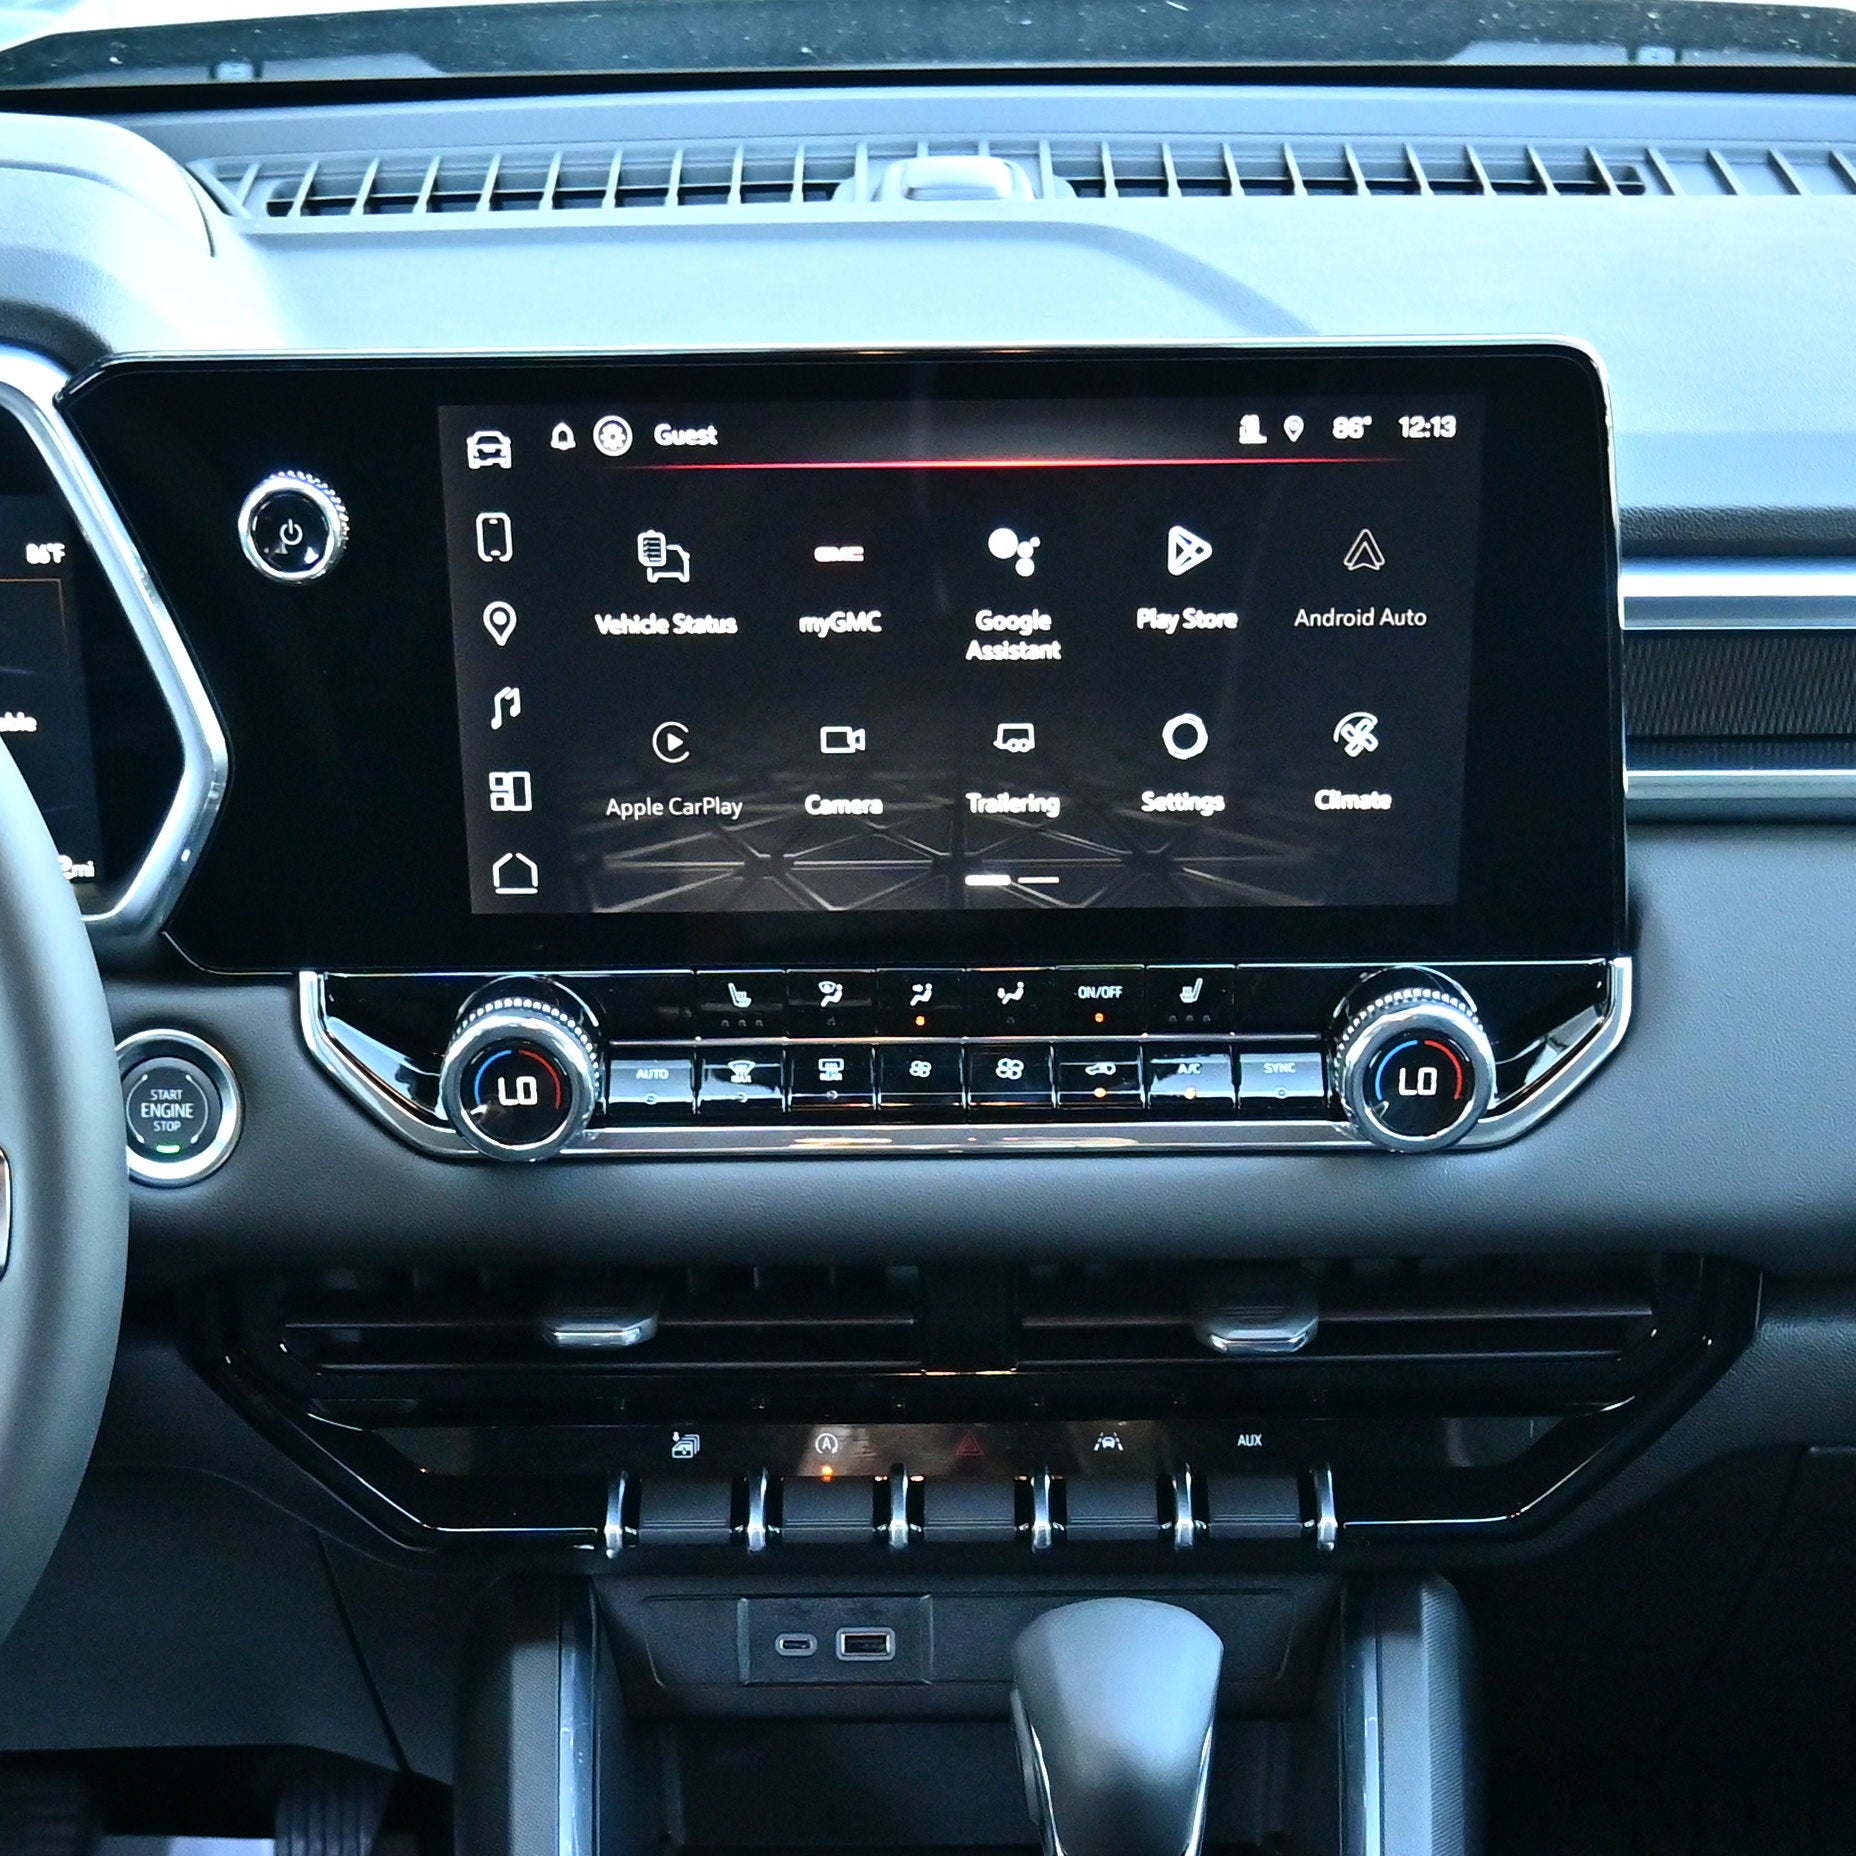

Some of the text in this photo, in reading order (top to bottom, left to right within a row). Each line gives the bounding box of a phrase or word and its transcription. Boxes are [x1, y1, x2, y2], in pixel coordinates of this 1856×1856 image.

[654, 424, 718, 447] Guest
[1332, 415, 1456, 438] 86° 12:13
[595, 612, 738, 637] Vehicle Status
[799, 611, 882, 638] myGMC
[975, 611, 1052, 634] Google
[1137, 608, 1238, 632] Play Store
[1295, 607, 1427, 628] Android Auto
[966, 640, 1061, 661] Assistant
[606, 796, 743, 822] Apple CarPlay
[804, 794, 883, 816] Camera
[966, 792, 1061, 818] Trailering
[1141, 791, 1225, 816] Settings
[1314, 789, 1392, 811] Climate
[1078, 985, 1123, 1000] ON/OFF
[636, 1069, 669, 1080] AUTO
[1177, 1062, 1201, 1075] A/C
[1263, 1061, 1296, 1074] SYNC
[498, 1075, 538, 1107] LO
[1398, 1067, 1438, 1097] LO
[151, 1089, 183, 1101] START
[141, 1103, 194, 1119] ENGINE
[153, 1120, 182, 1132] STOP
[1237, 1433, 1262, 1447] AUX
